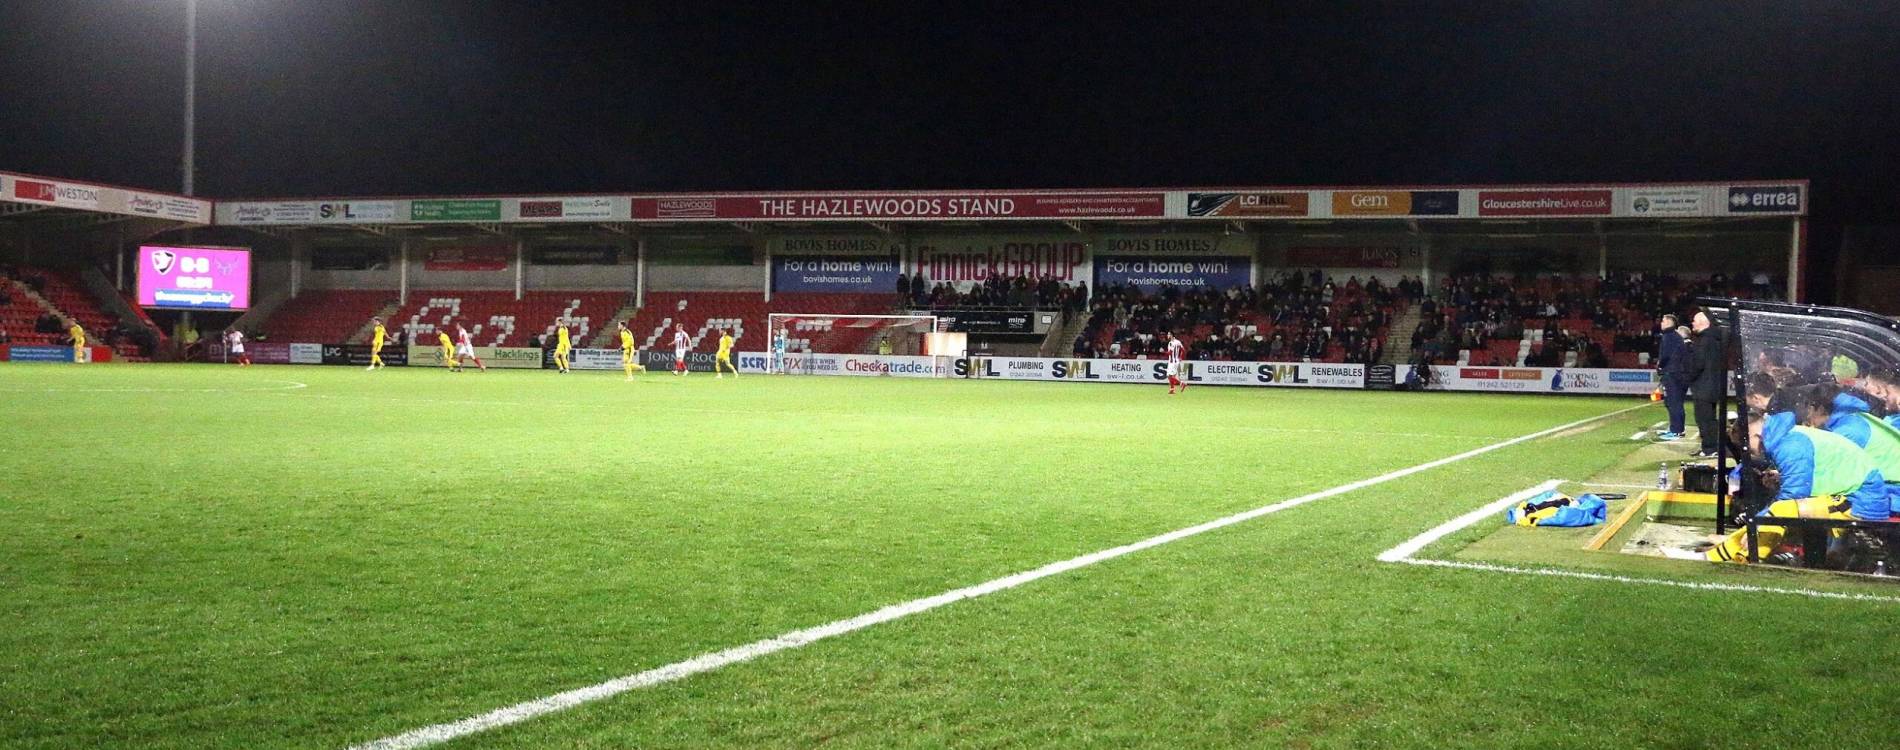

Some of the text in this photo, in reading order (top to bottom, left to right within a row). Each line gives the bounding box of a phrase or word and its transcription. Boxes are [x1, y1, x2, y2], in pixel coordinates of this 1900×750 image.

[56, 185, 98, 201] WESTON
[1752, 191, 1797, 206] errea
[661, 201, 713, 209] HAZLEWOODS
[1351, 193, 1388, 207] Gem
[1482, 198, 1607, 209] GloucestershireLive.co.uk
[760, 199, 1015, 215] THE HAZLEWOODS STAND
[785, 239, 877, 251] BOVIS HOMES
[1109, 238, 1210, 251] BOVIS HOMES
[784, 259, 892, 272] For a home win!
[1107, 260, 1229, 274] For a home win!
[803, 275, 872, 284] bovishomes.co.uk
[495, 349, 540, 359] Hacklings
[1009, 361, 1043, 370] PLUMBING
[1052, 360, 1099, 378] SWL
[1111, 363, 1141, 372] HEATING
[1208, 365, 1251, 374] ELECTRICAL
[1312, 366, 1362, 377] RENEWABLES
[1258, 364, 1308, 383] SWL
